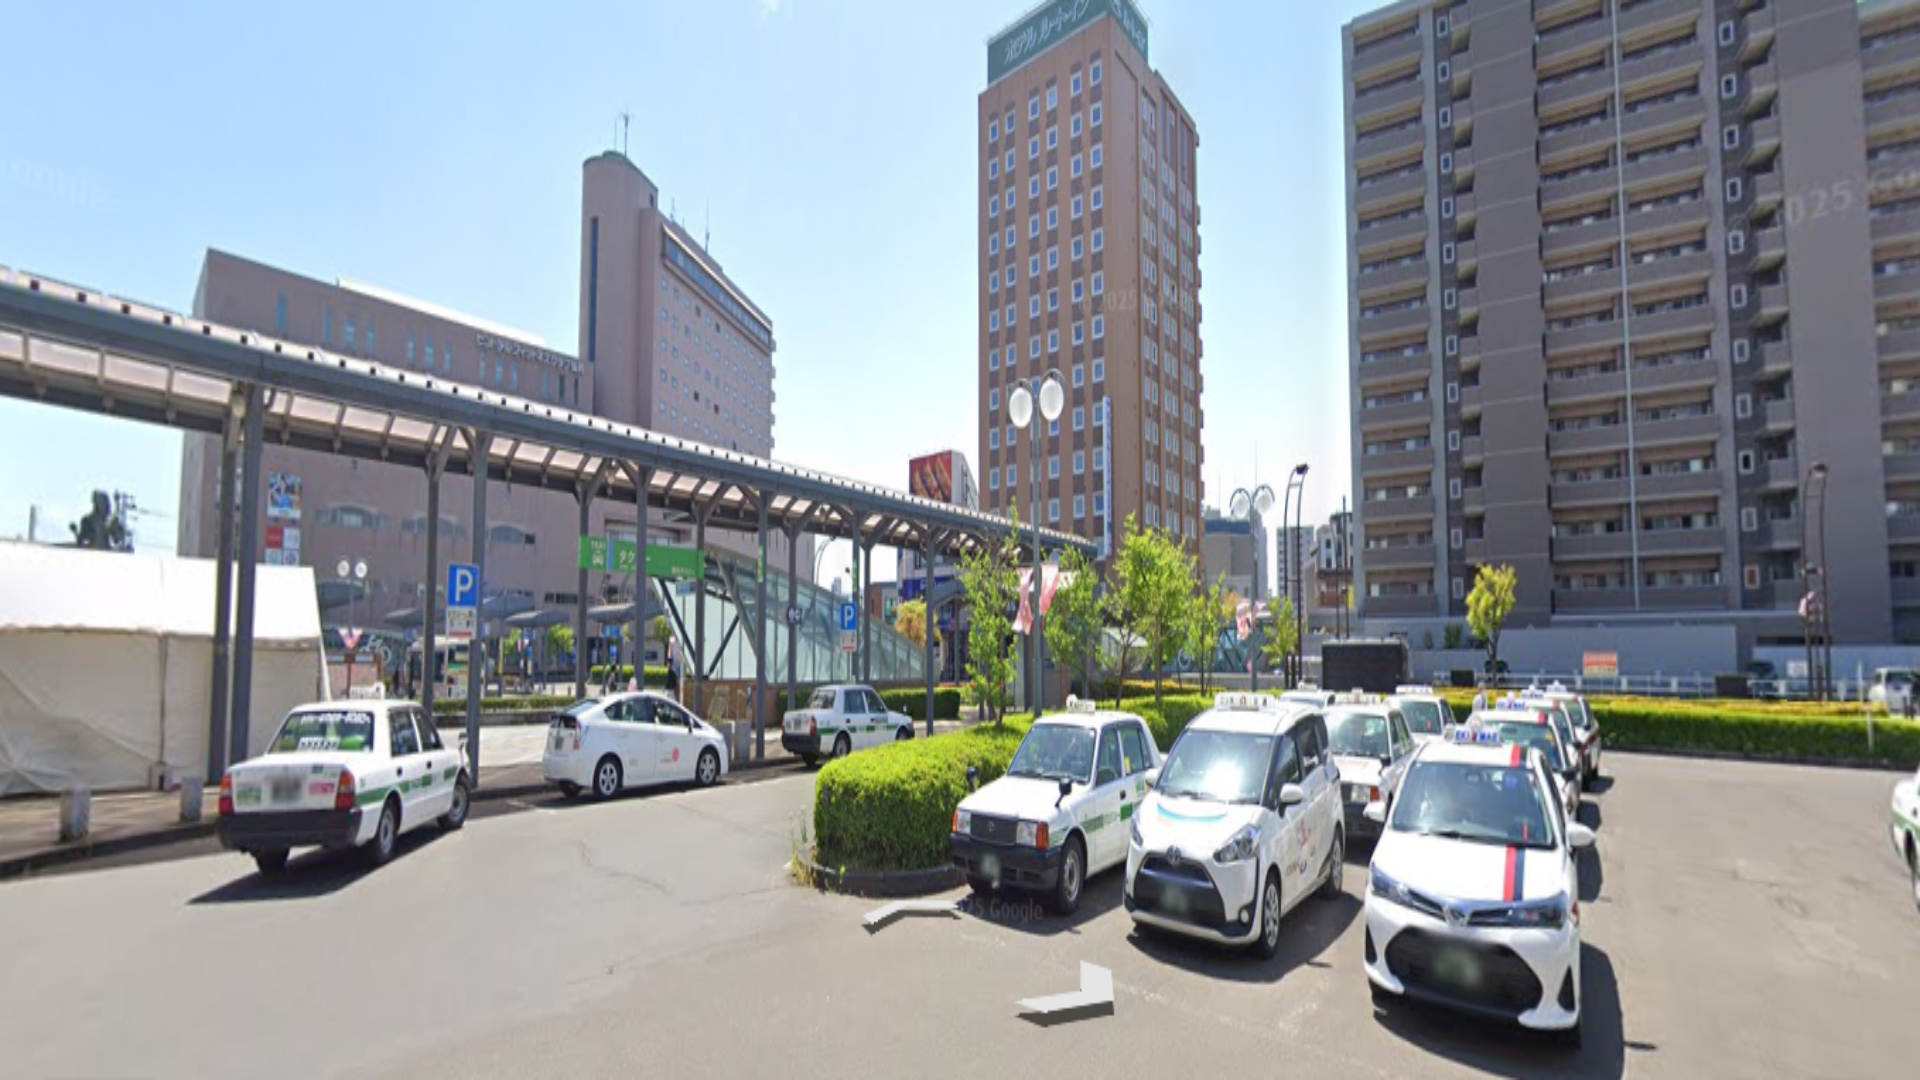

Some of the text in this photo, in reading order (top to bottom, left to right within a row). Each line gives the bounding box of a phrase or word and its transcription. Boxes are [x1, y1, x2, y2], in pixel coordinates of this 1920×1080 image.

[619, 549, 651, 564] タクー
[455, 568, 473, 602] P
[843, 604, 855, 629] P
